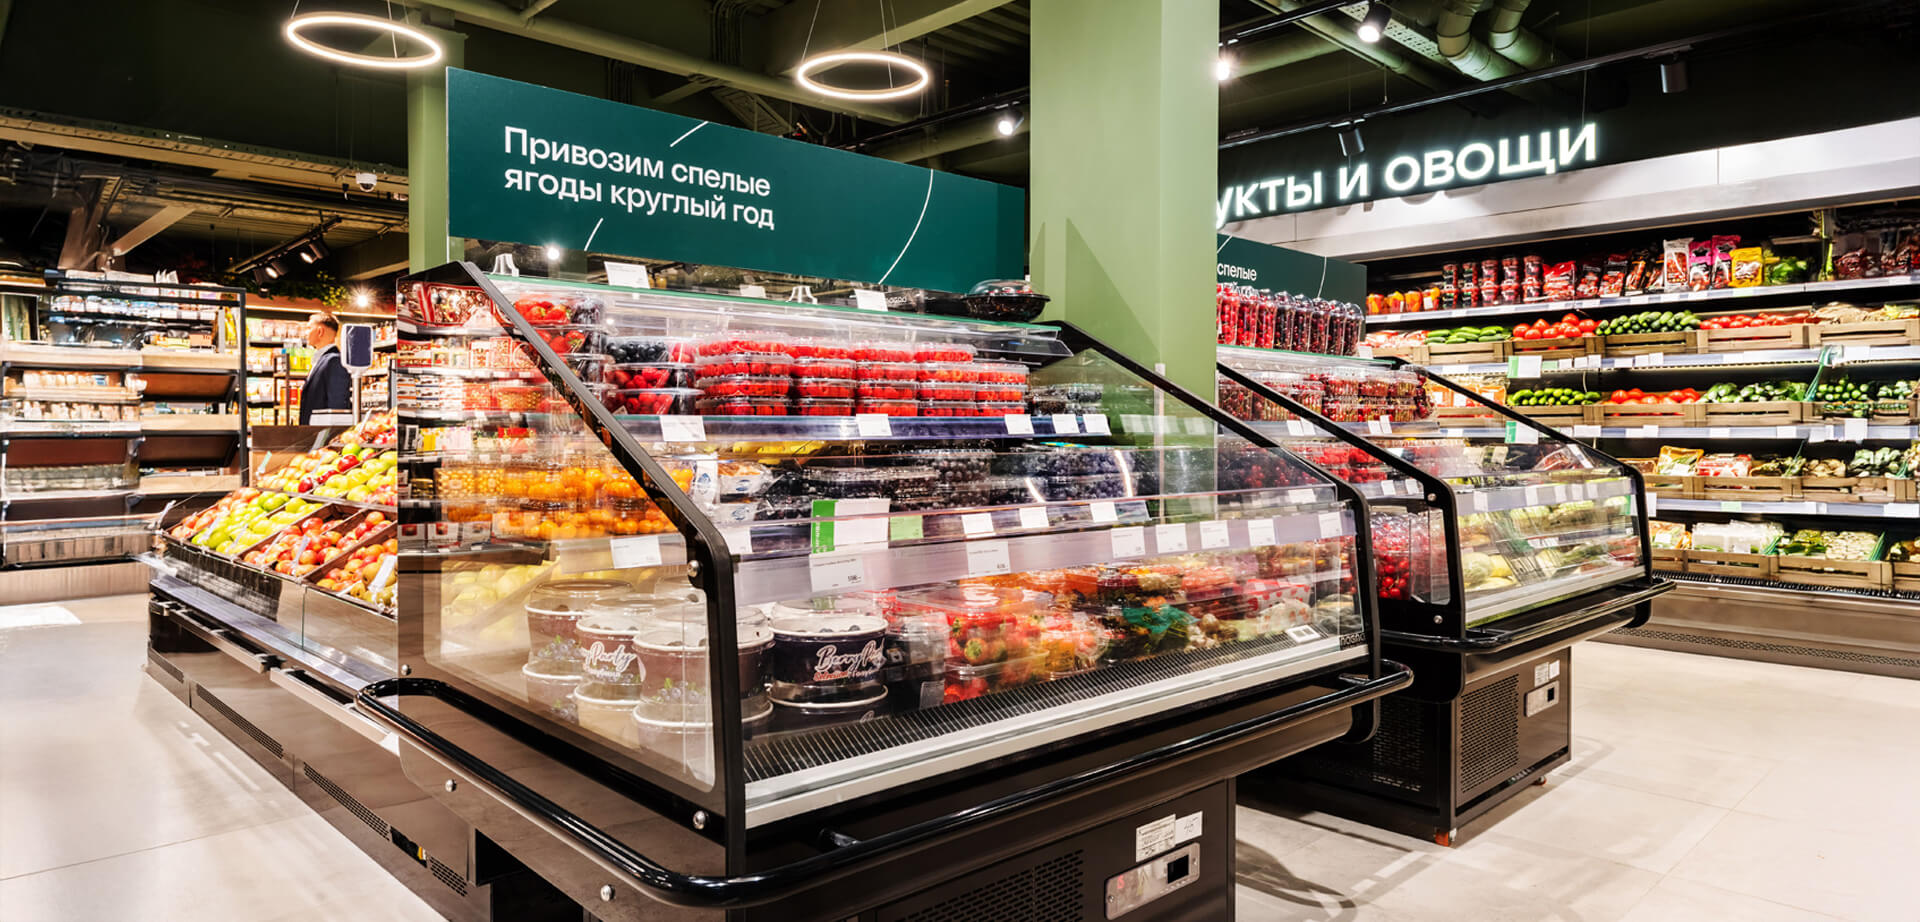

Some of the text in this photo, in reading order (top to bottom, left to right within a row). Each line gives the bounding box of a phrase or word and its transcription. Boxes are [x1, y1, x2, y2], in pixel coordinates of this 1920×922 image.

[504, 125, 771, 197] Привозим спелые
[503, 168, 775, 231] ягоды круглый год
[1217, 262, 1258, 282] спелые
